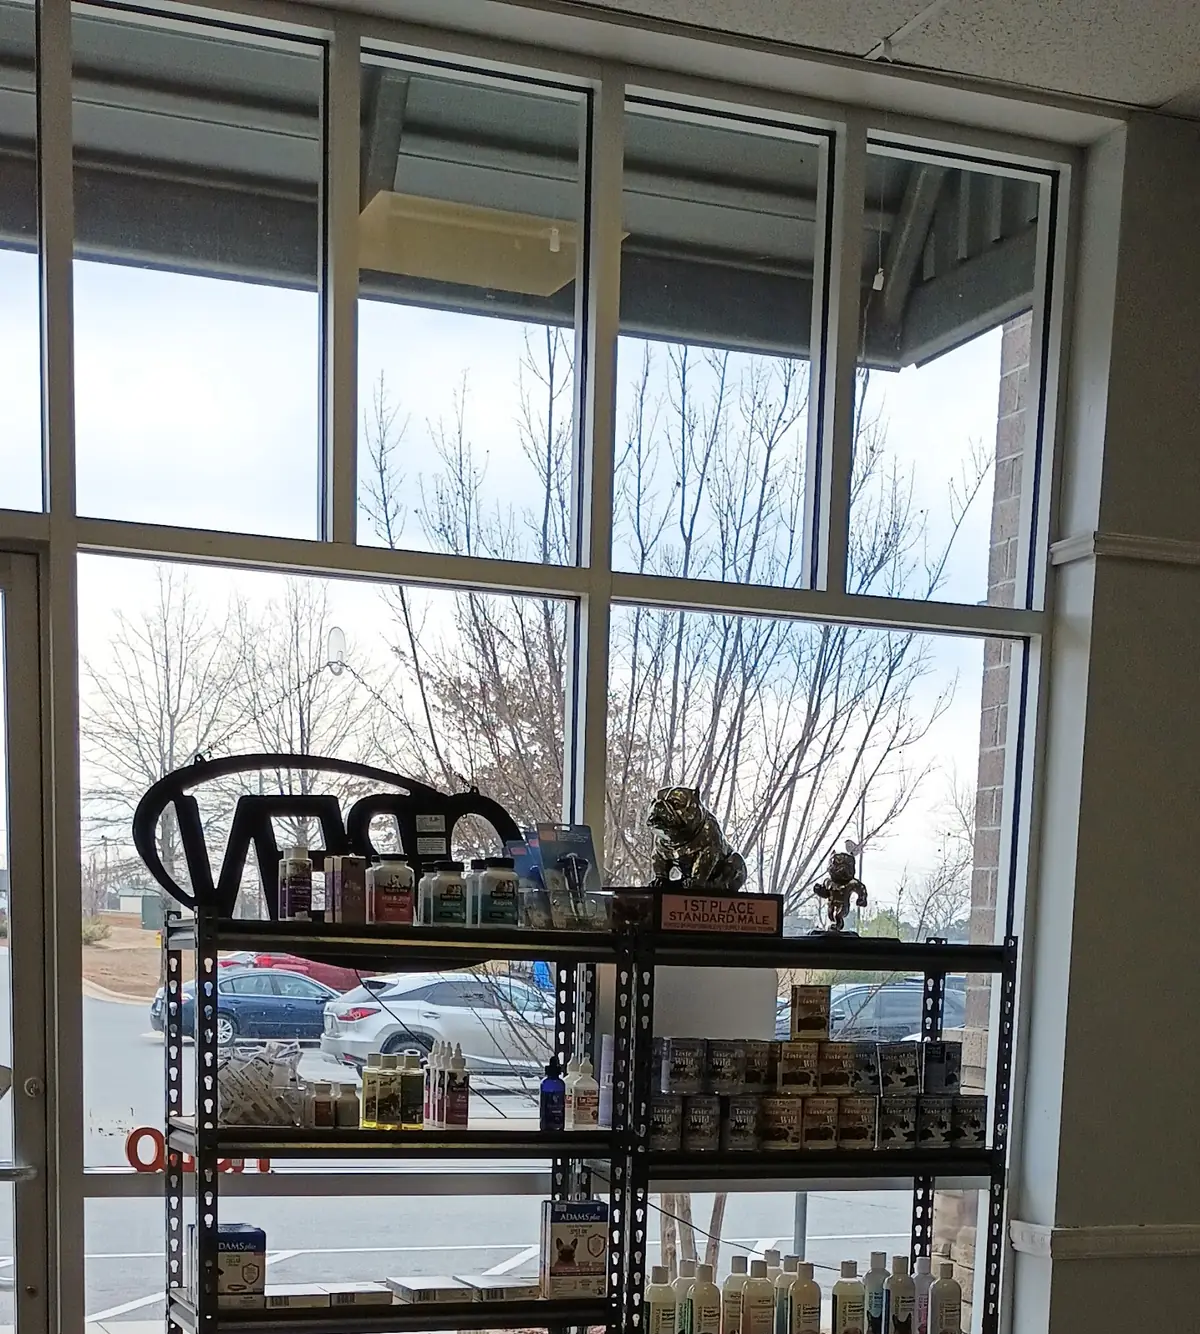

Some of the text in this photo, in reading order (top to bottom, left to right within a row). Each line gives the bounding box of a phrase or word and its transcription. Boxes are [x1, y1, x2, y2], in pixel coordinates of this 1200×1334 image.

[683, 899, 755, 915] 1ST PLACE
[669, 911, 770, 926] STANDARD MALE
[560, 1213, 589, 1221] ADAMS
[218, 1242, 245, 1251] DAMS
